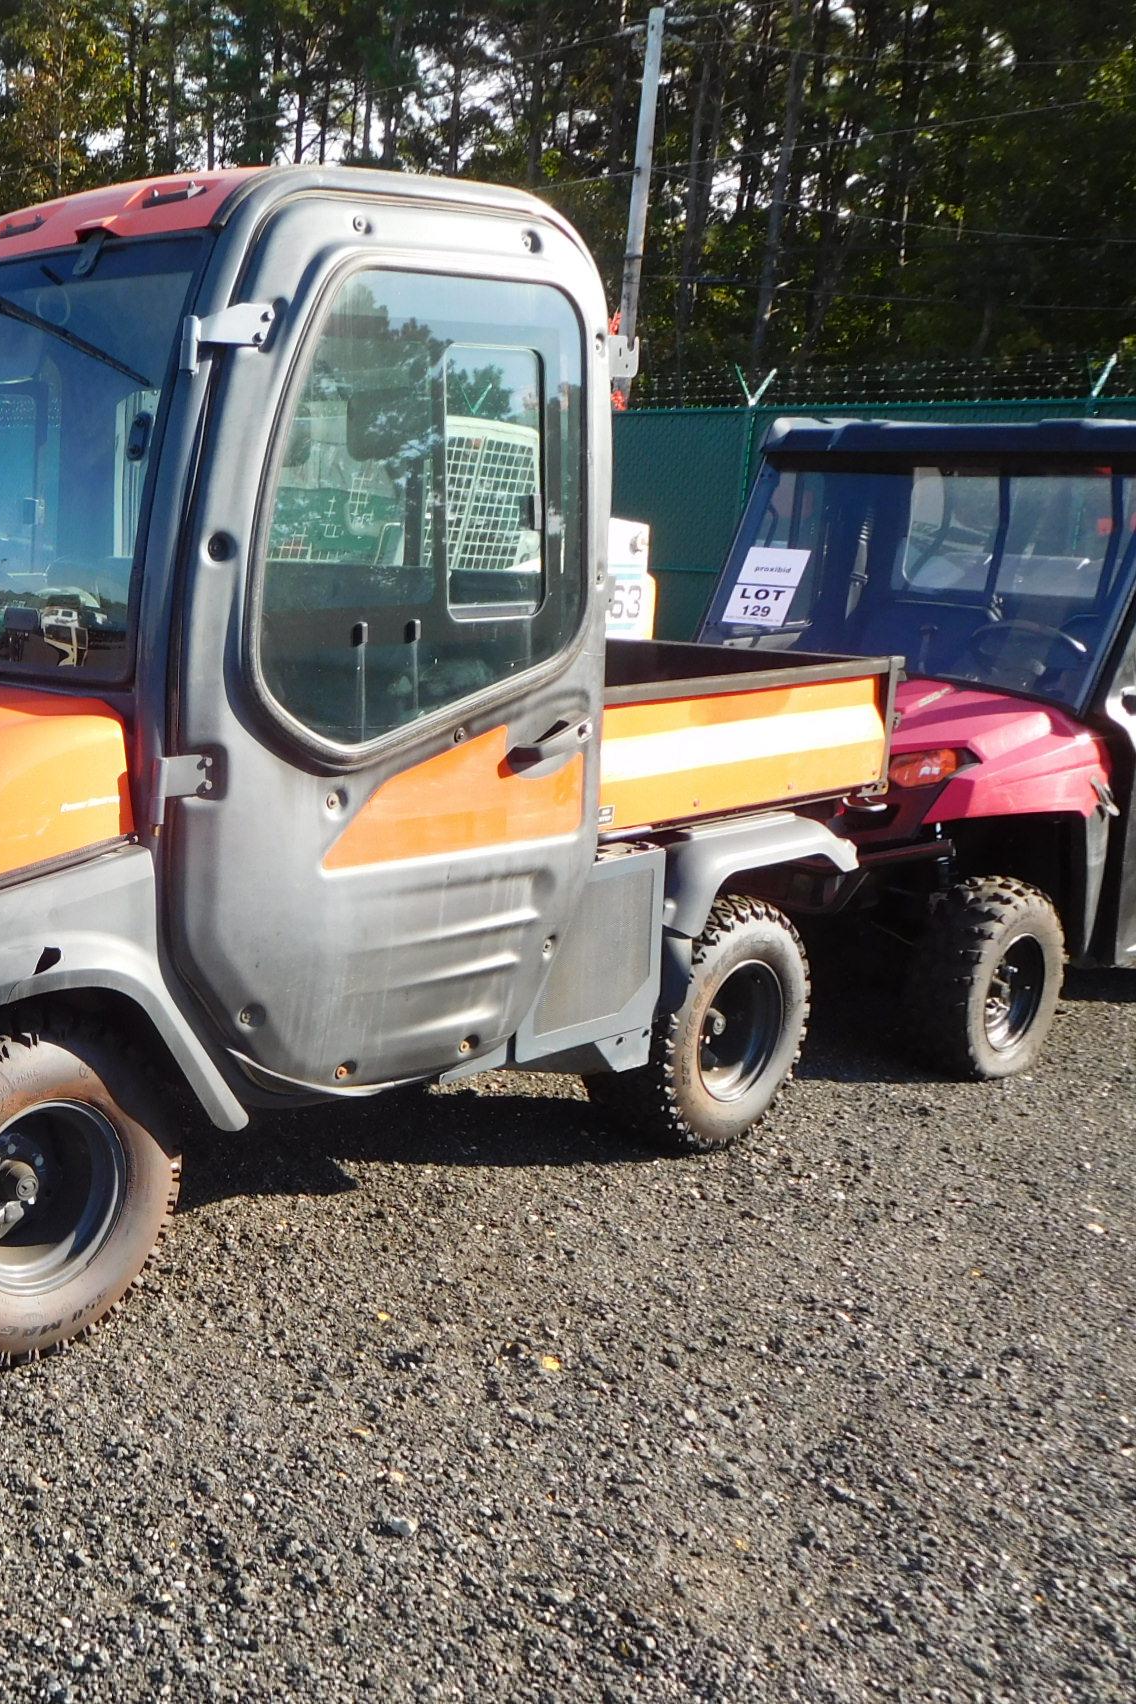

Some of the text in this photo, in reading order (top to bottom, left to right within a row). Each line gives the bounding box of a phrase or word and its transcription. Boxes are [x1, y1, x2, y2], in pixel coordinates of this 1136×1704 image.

[754, 566, 792, 574] proxibid
[740, 587, 786, 602] LOT
[742, 604, 771, 617] 129
